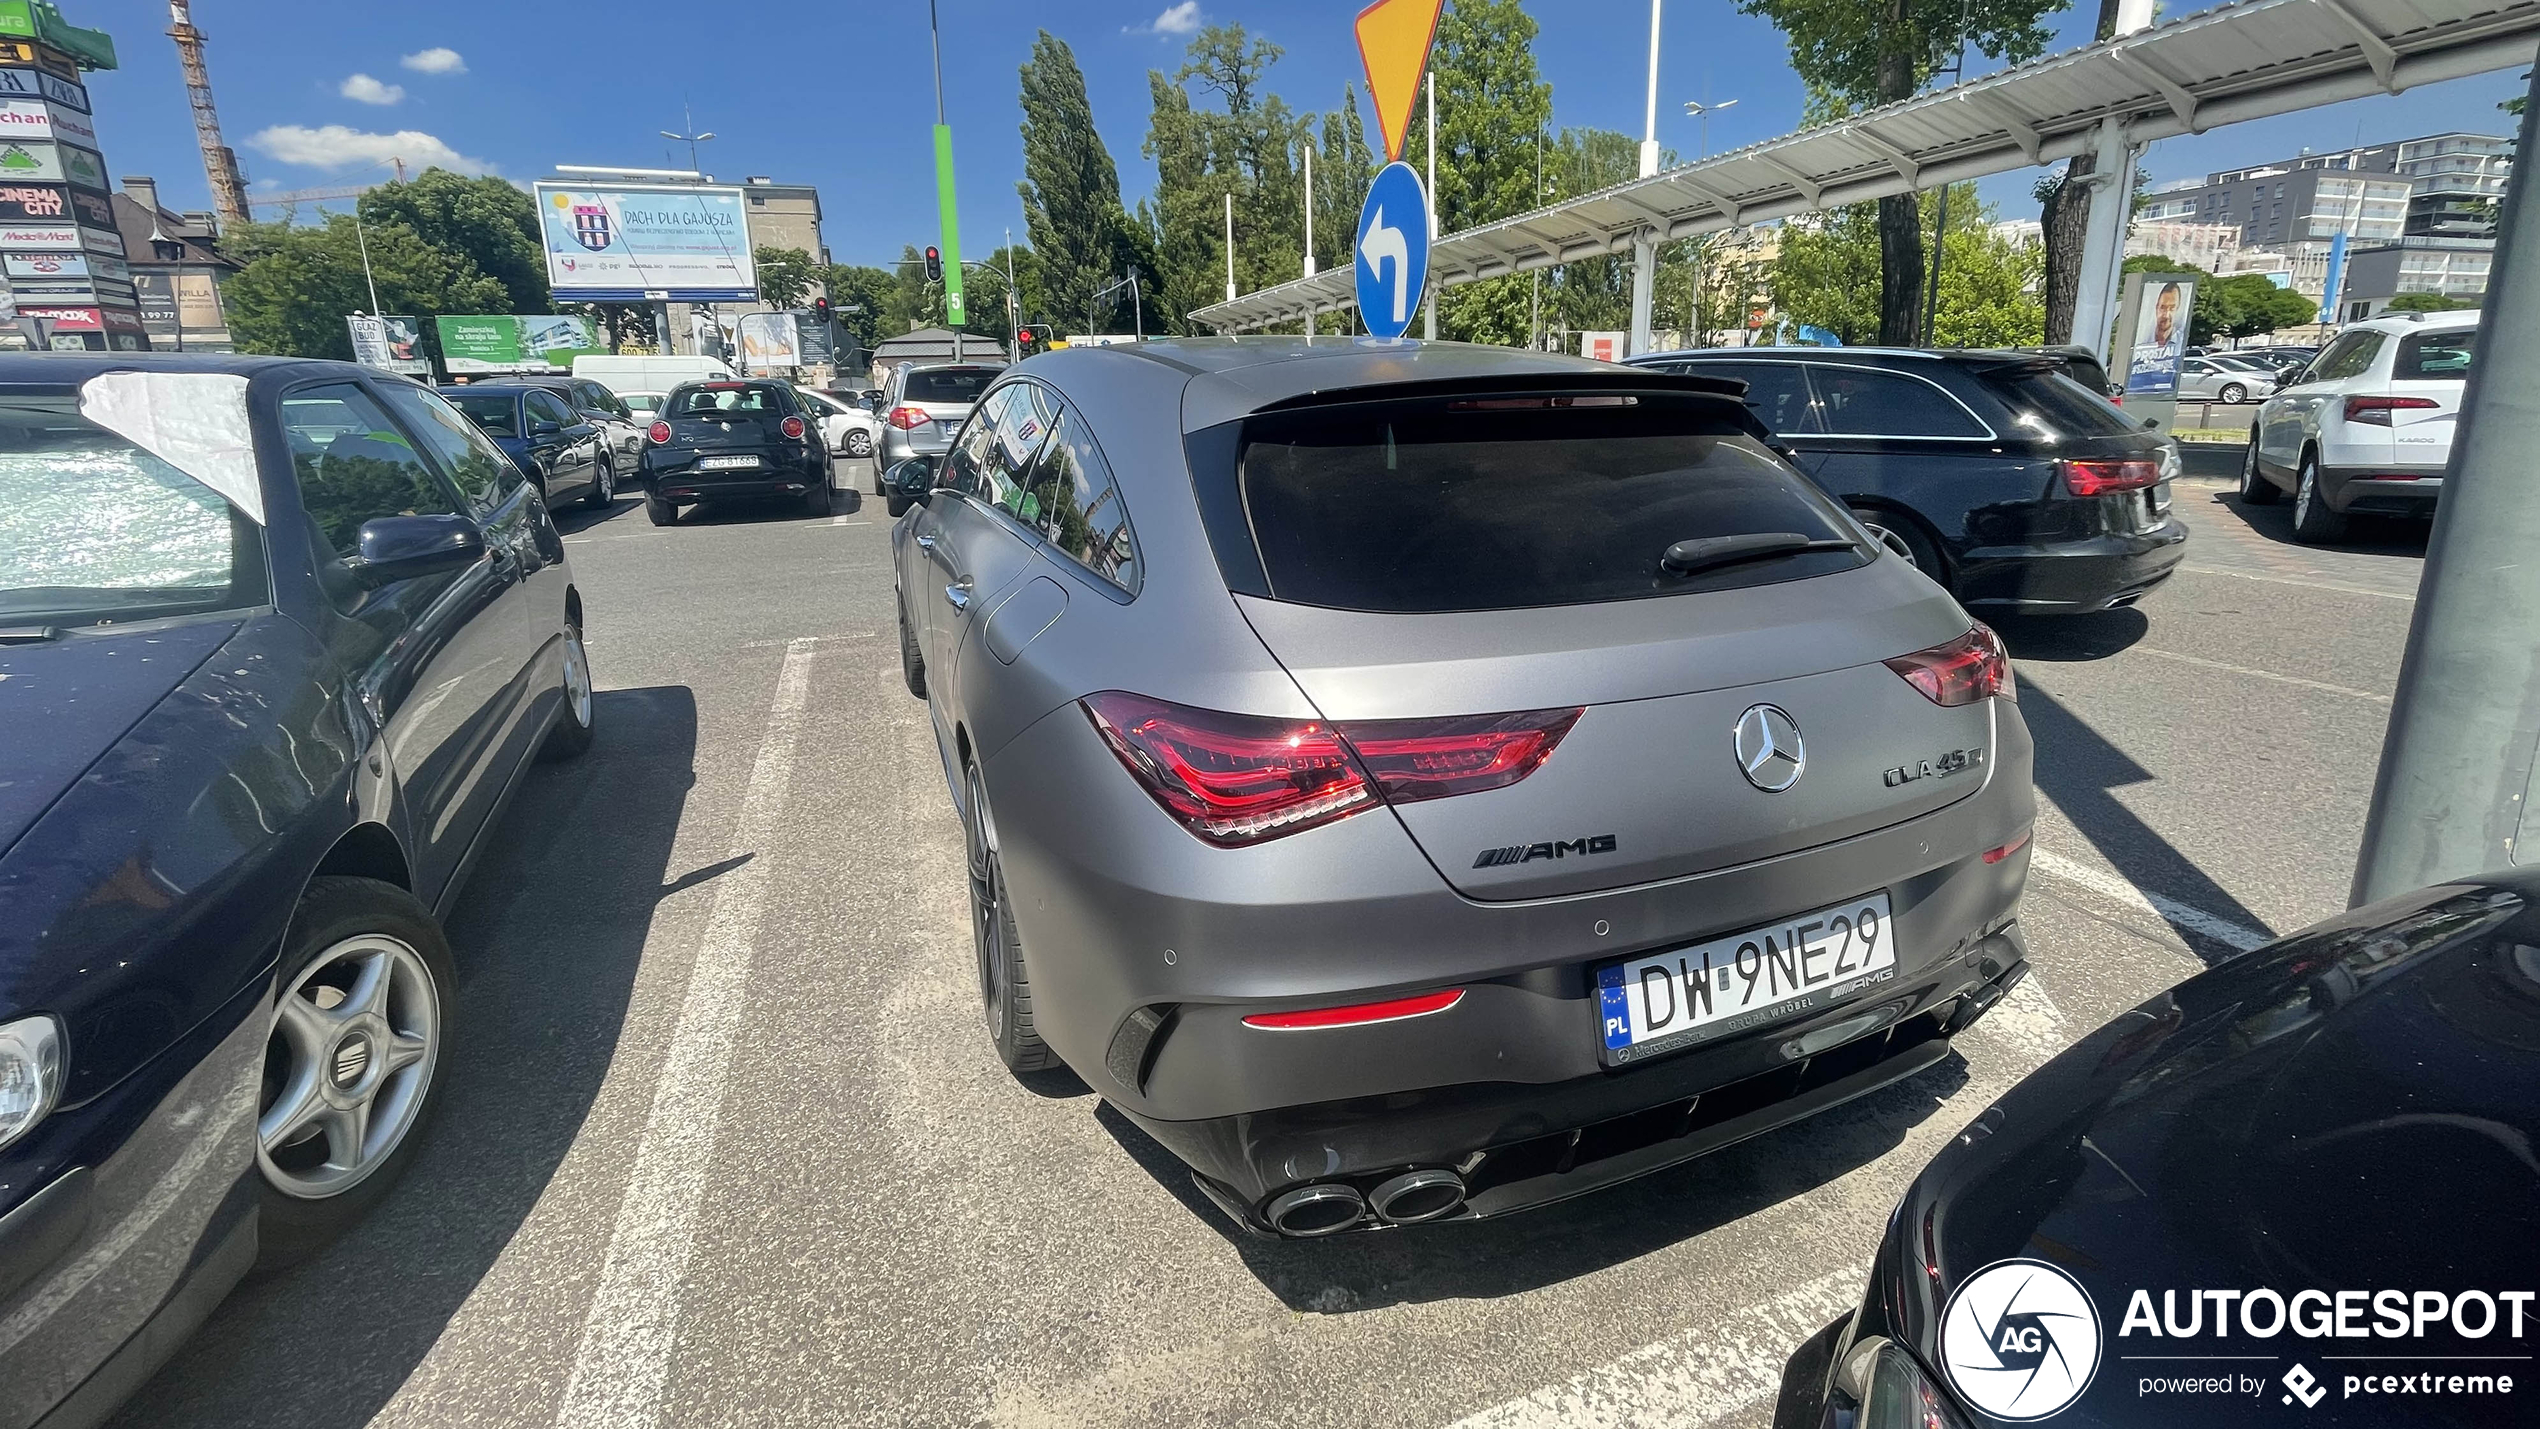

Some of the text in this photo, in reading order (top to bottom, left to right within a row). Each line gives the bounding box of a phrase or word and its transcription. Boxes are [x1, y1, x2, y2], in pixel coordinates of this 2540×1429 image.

[25, 201, 62, 216] CITY
[625, 210, 734, 227] DACH DLA GAJUSZA
[951, 293, 960, 310] 5
[1883, 760, 1933, 788] CLA
[1639, 907, 1880, 1033] DW 9NE29
[1850, 968, 1895, 993] AMG
[1606, 1016, 1629, 1038] PL
